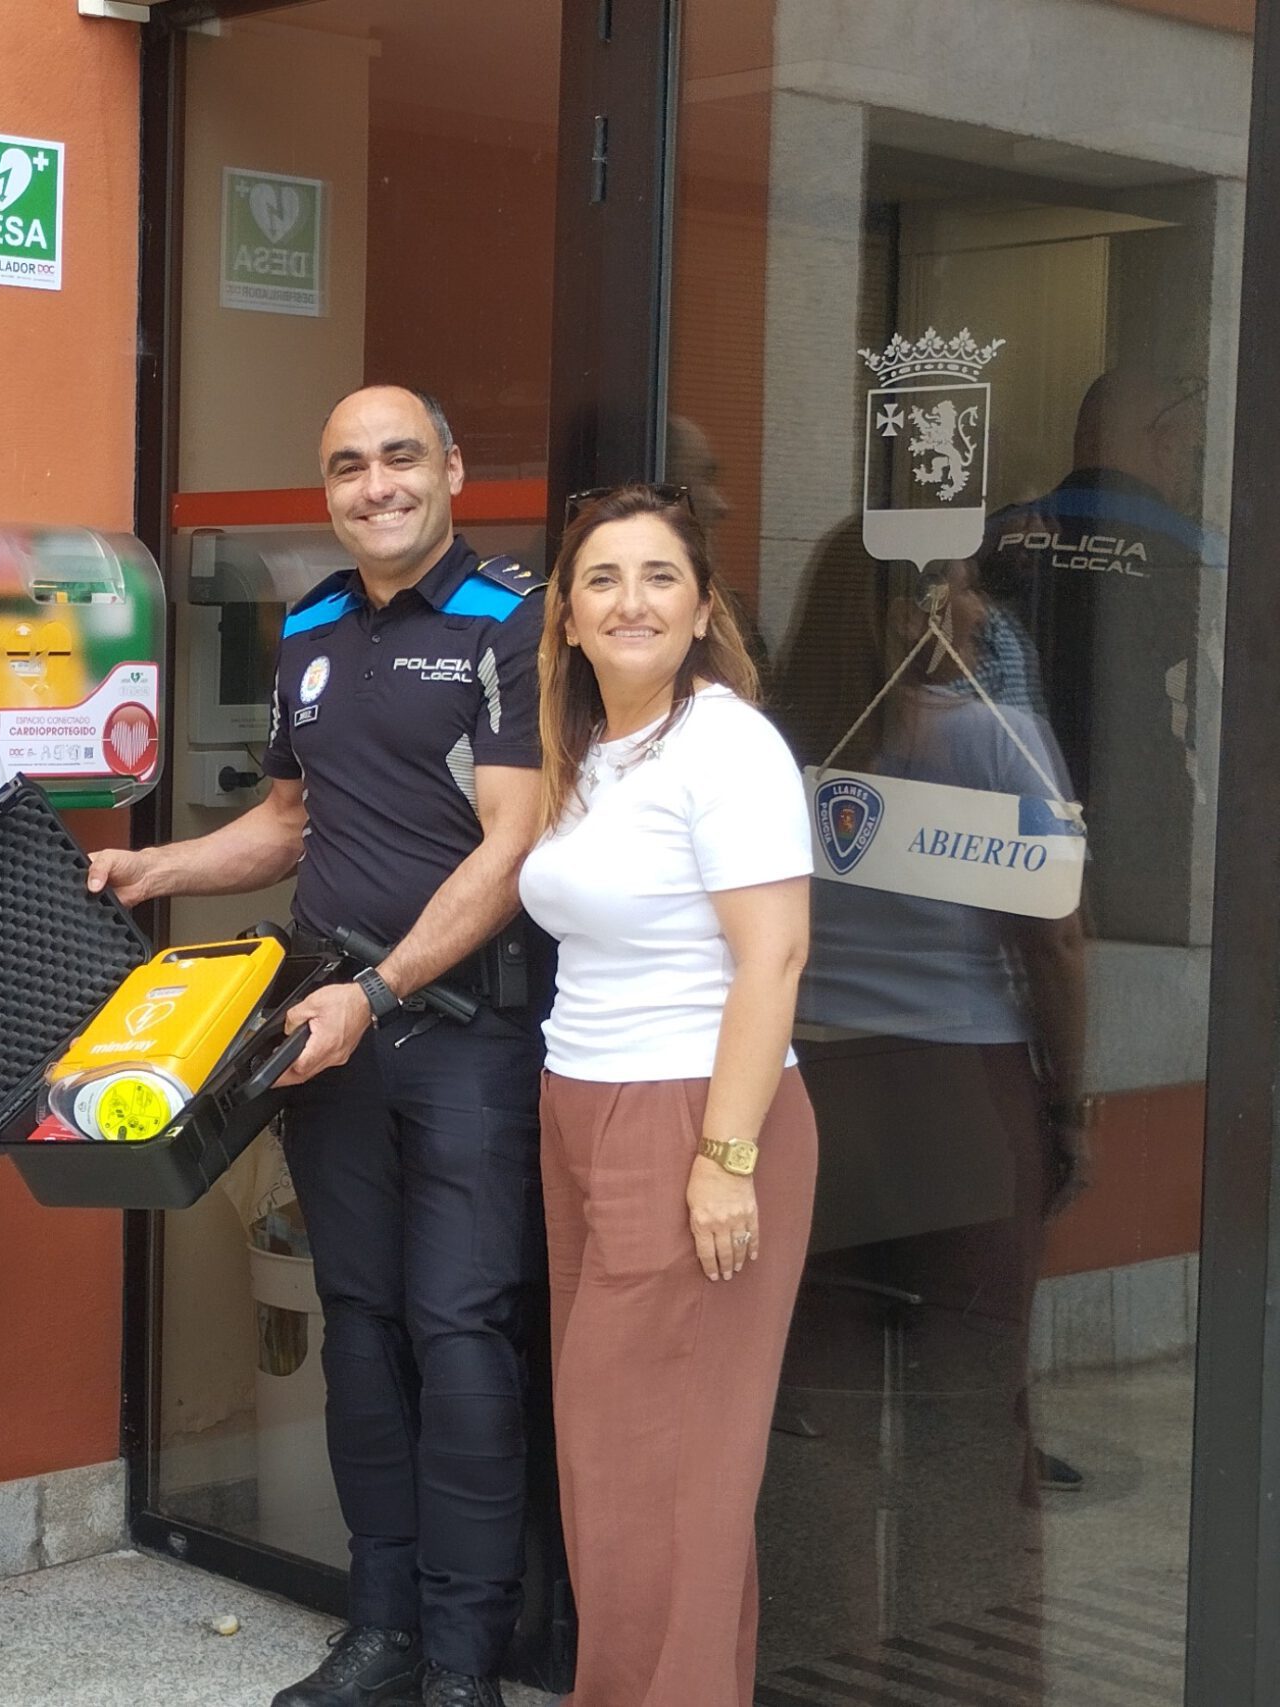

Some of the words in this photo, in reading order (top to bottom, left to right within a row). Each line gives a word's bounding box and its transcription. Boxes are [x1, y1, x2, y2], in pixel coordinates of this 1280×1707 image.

[37, 263, 55, 275] DOC
[997, 532, 1147, 562] POLICIA
[1052, 555, 1146, 578] LOCAL
[393, 657, 472, 672] POLICIA
[420, 671, 473, 683] LOCAL
[15, 716, 46, 725] ESPACIO
[46, 715, 91, 725] CONECTADO
[9, 726, 97, 736] CARDIOPROTEGIDO
[8, 748, 25, 757] DOC
[832, 785, 869, 801] LLANES
[855, 815, 877, 850] LOCAL
[907, 827, 1048, 872] ABIERTO
[90, 1039, 157, 1054] mindray
